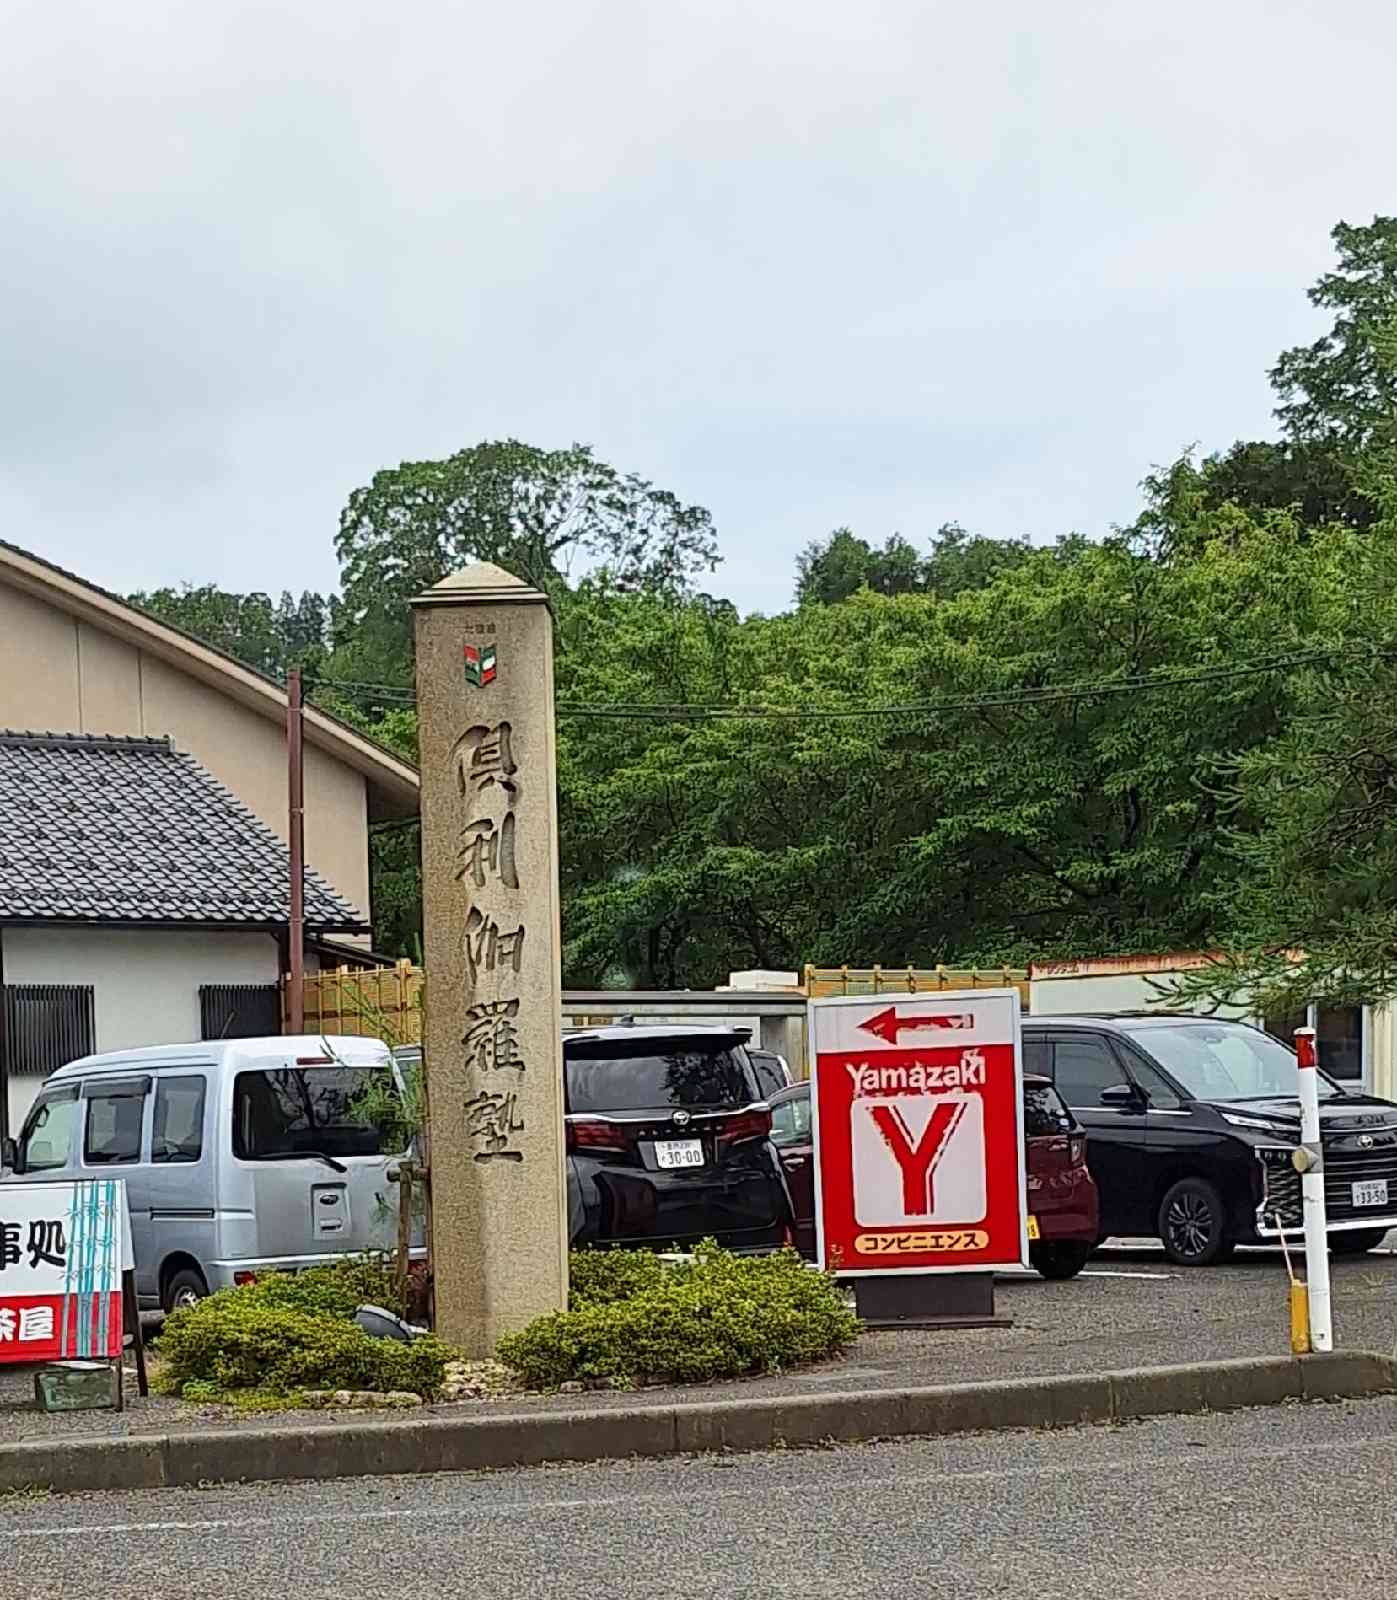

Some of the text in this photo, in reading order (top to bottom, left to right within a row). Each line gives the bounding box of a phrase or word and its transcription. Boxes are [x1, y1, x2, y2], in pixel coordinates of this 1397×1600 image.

[846, 1052, 986, 1093] Yamazaki
[868, 1102, 967, 1217] Y
[863, 1231, 980, 1251] コンビニエンス
